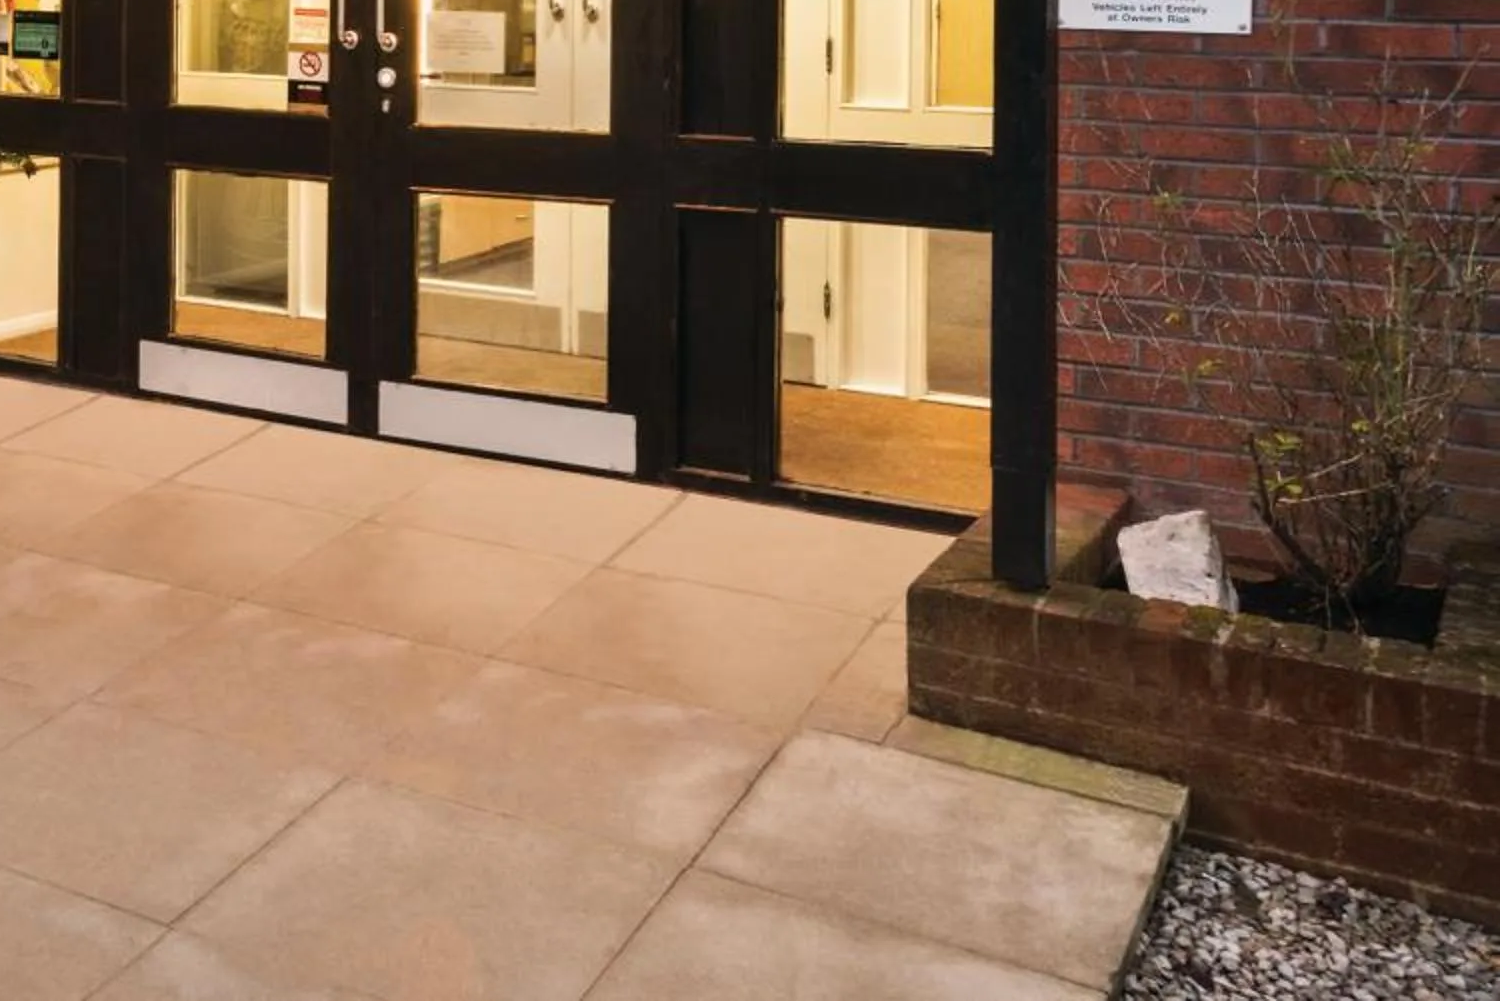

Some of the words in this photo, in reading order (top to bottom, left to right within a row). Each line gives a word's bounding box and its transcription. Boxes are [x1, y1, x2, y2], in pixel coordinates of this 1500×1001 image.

[1092, 2, 1136, 11] Vehicles
[1140, 4, 1162, 12] Left
[1166, 4, 1207, 15] Entirely
[1122, 14, 1163, 23] Owners
[1167, 15, 1191, 23] Risk
